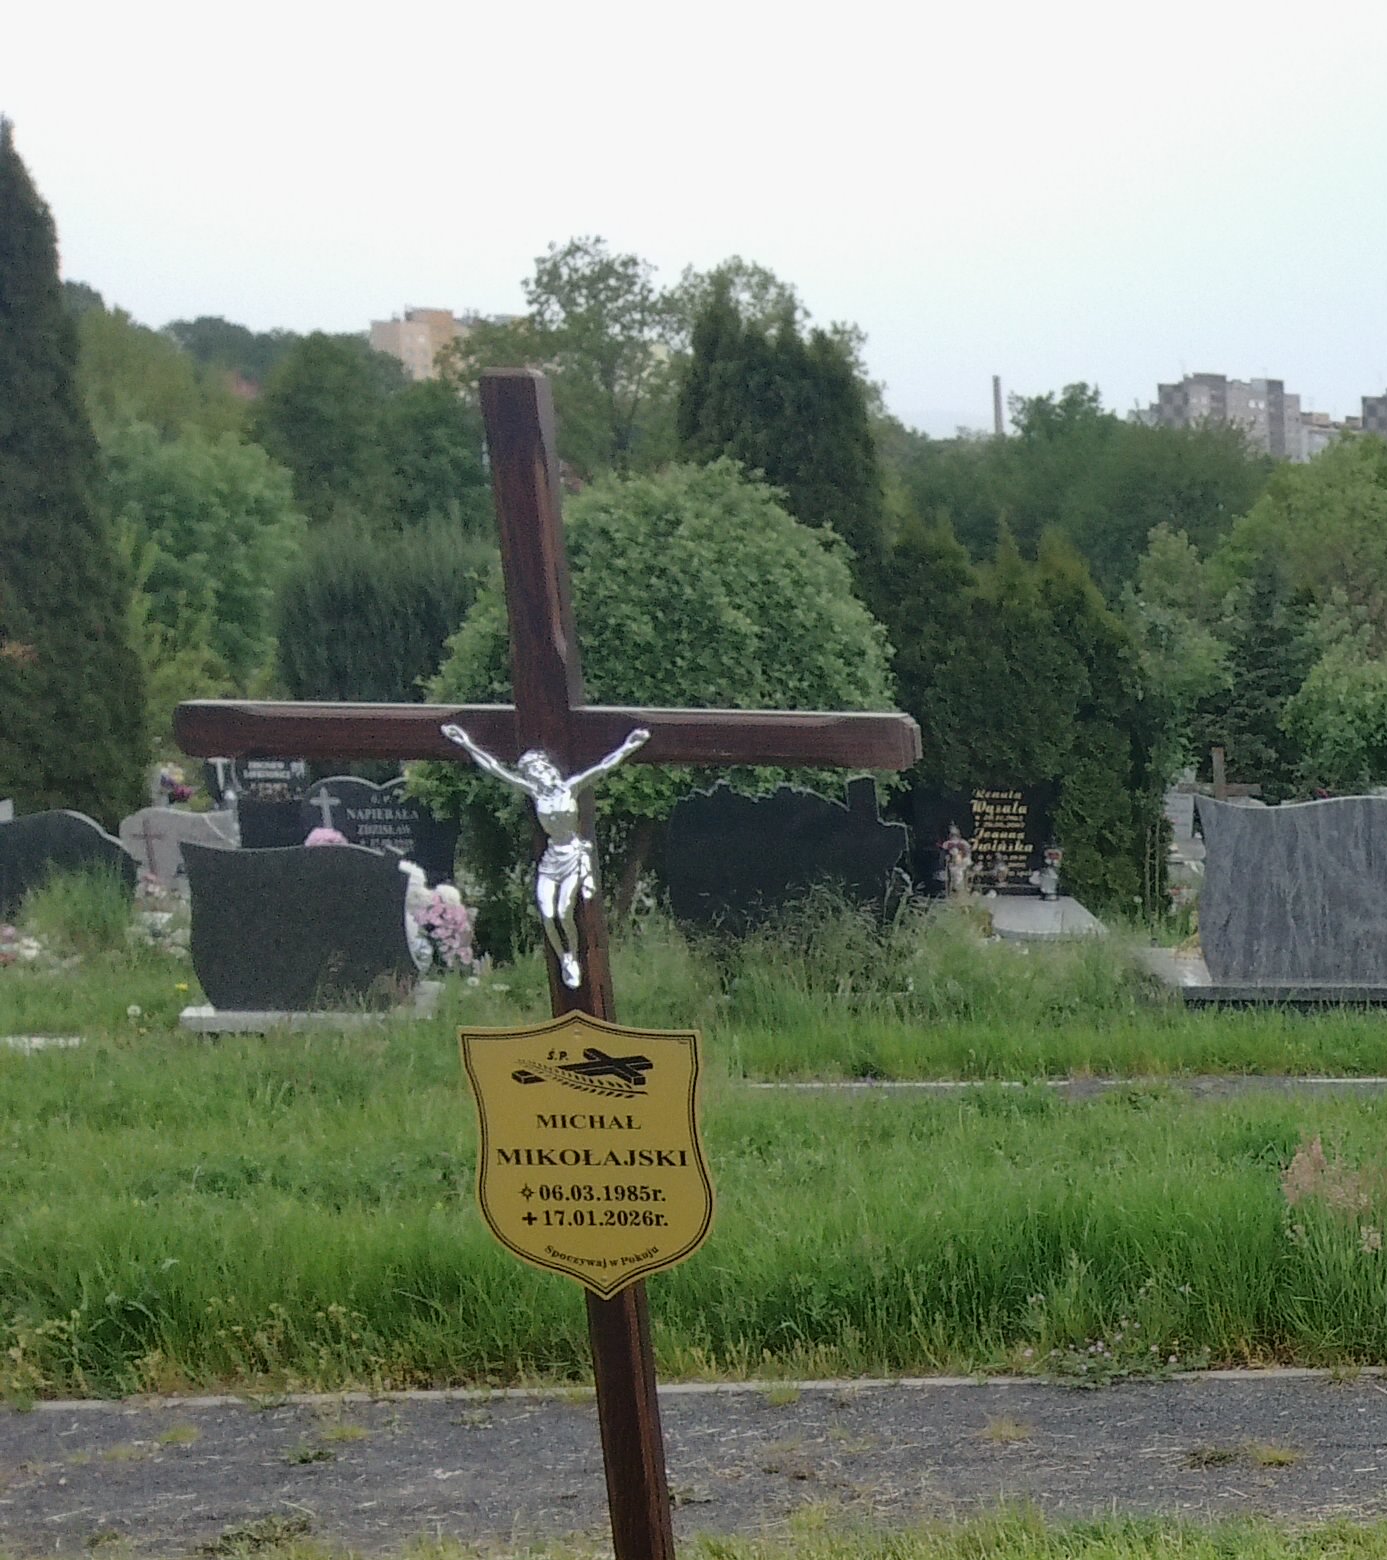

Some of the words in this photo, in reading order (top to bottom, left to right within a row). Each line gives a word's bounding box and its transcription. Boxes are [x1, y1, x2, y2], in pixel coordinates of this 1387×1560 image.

[536, 1114, 642, 1130] MICHAŁ
[496, 1148, 690, 1167] MIKOŁAJSKI
[539, 1184, 667, 1202] 06.03.1985r.
[543, 1210, 669, 1227] 17.01.2026r.
[545, 1244, 607, 1269] Spoczywaj
[620, 1246, 659, 1266] Pokoju
